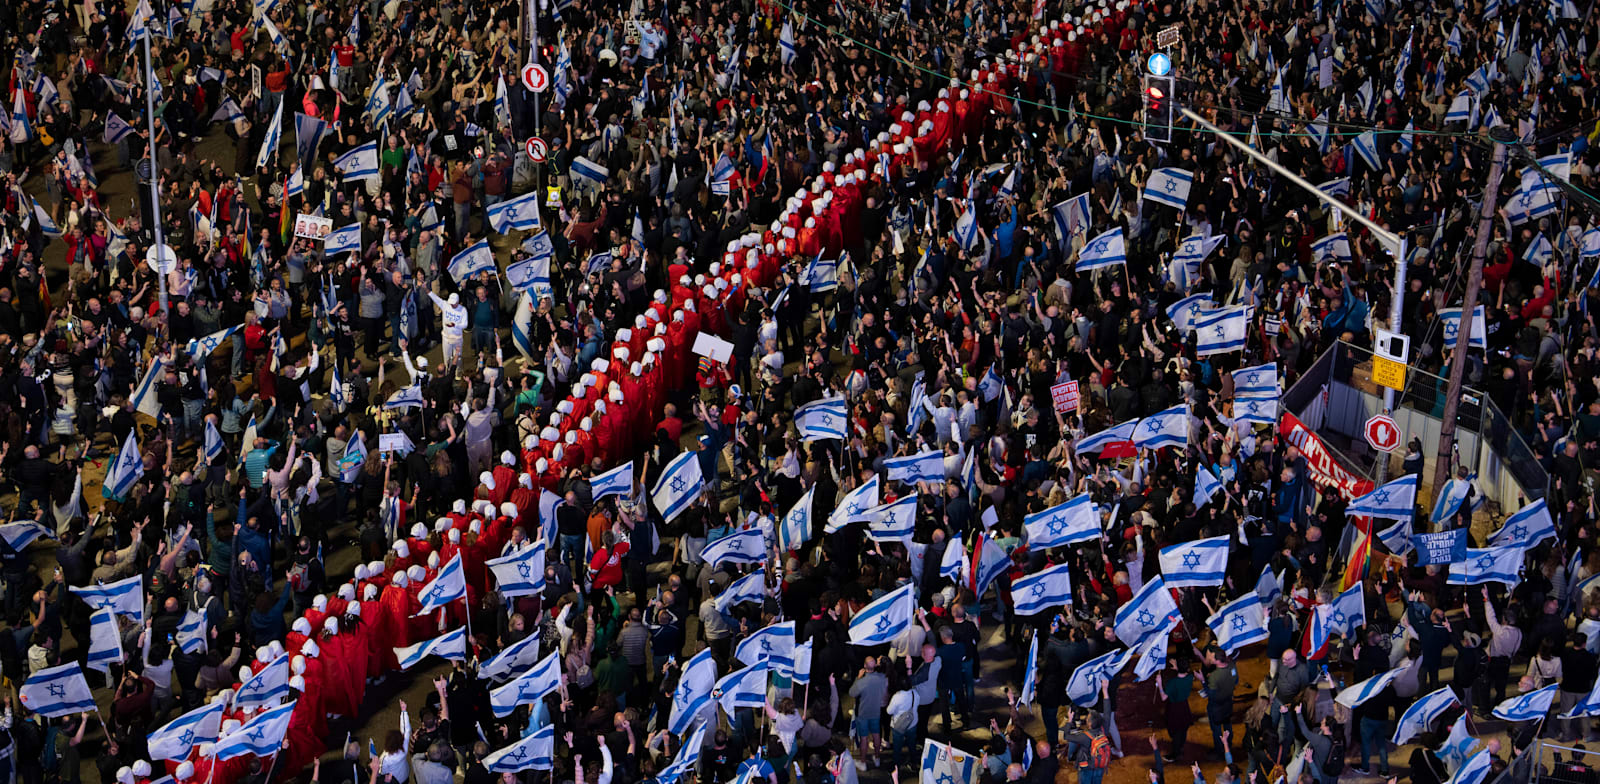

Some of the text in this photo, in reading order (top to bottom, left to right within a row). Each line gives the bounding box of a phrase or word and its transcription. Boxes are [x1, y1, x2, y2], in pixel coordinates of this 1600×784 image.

[1288, 424, 1331, 476] בריאות
[1333, 463, 1358, 491] אין
[1421, 531, 1456, 543] דיקטטורה
[1429, 548, 1450, 557] הנפש
